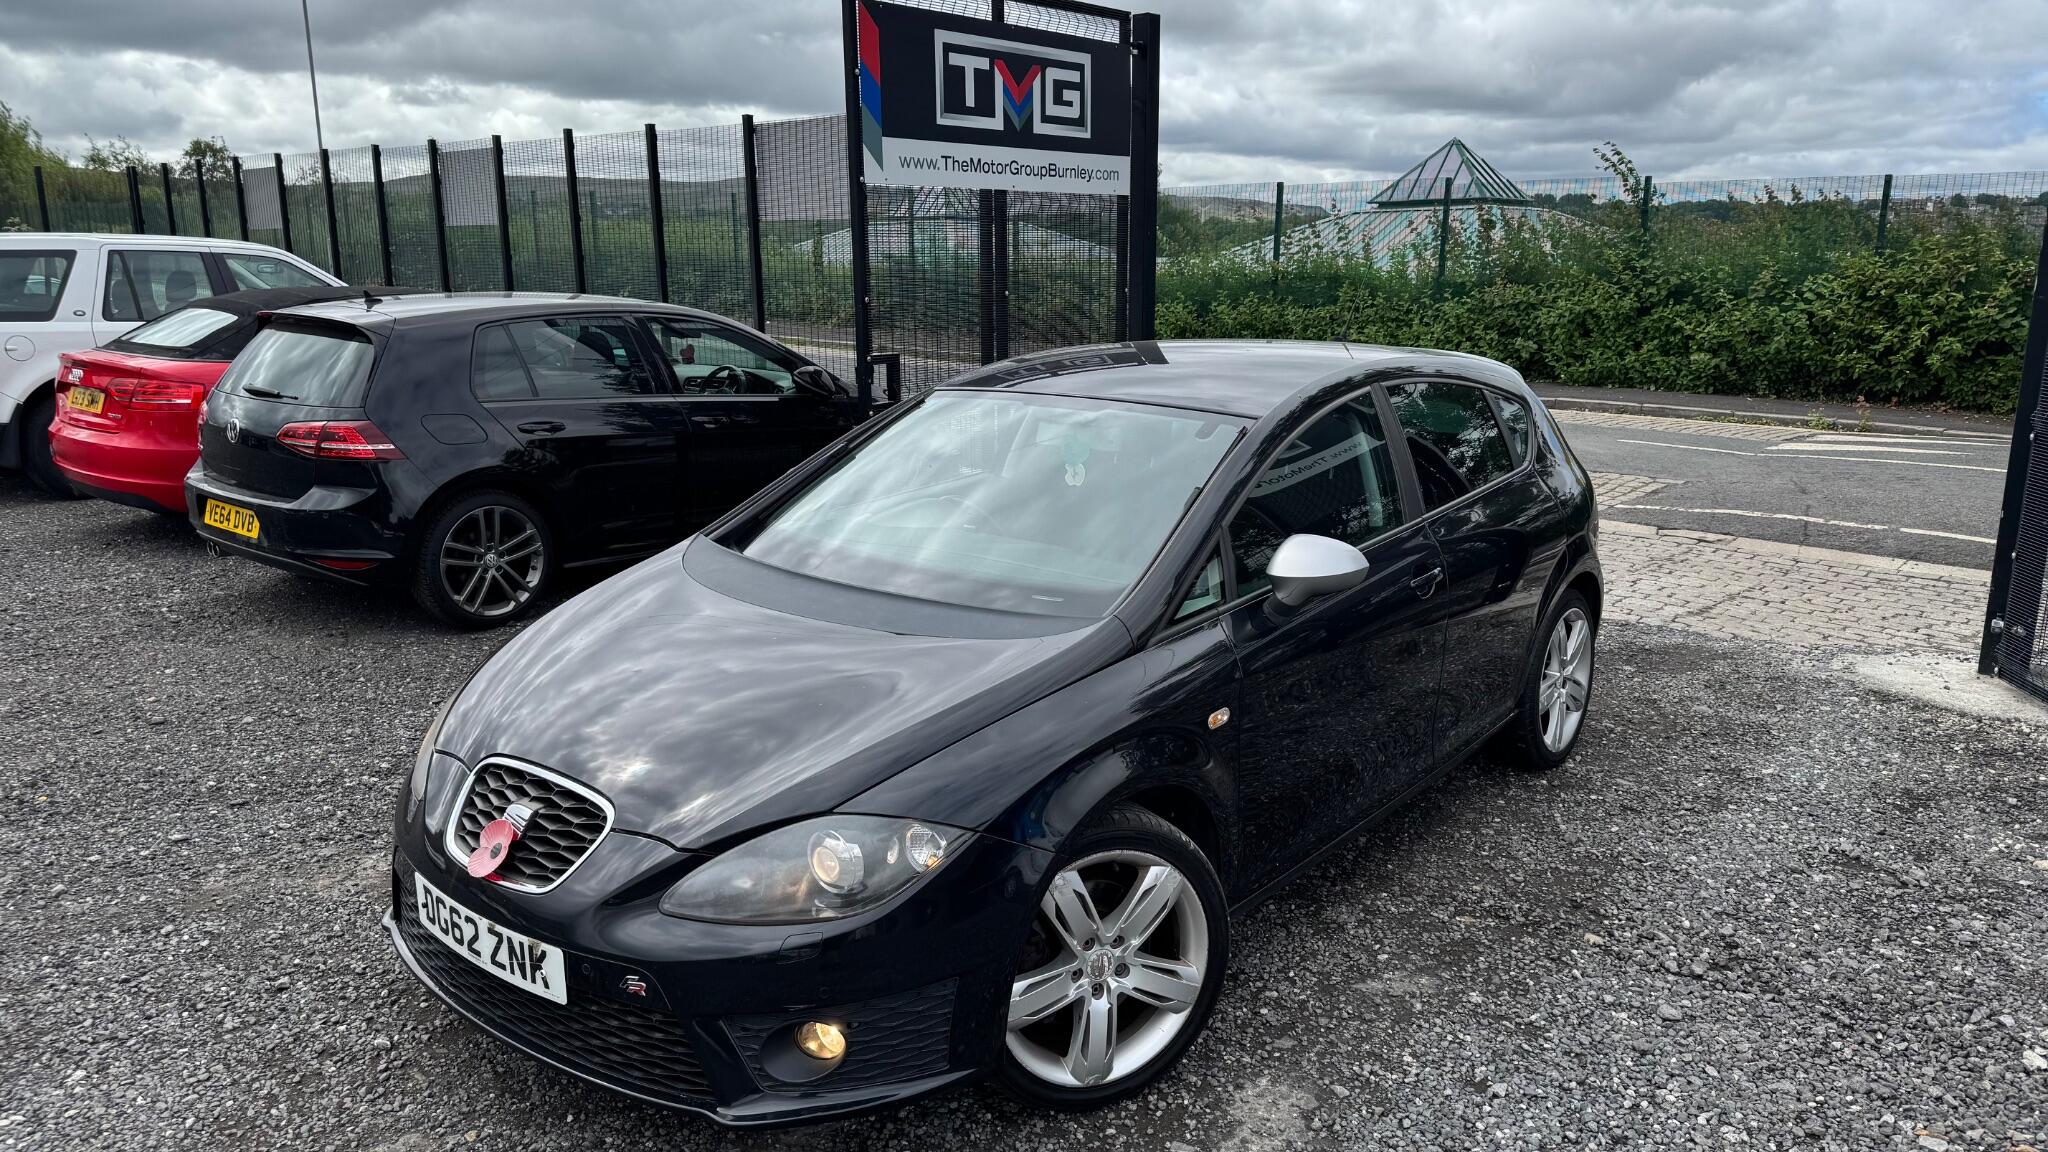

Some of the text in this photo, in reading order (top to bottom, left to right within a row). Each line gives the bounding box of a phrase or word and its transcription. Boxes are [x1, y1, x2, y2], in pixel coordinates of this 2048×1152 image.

[949, 52, 1081, 132] TMG
[899, 155, 1119, 182] www.TheMotorGroupBurnley.com
[208, 502, 255, 533] VE64 DVB
[422, 884, 550, 990] DG62 ZNK
